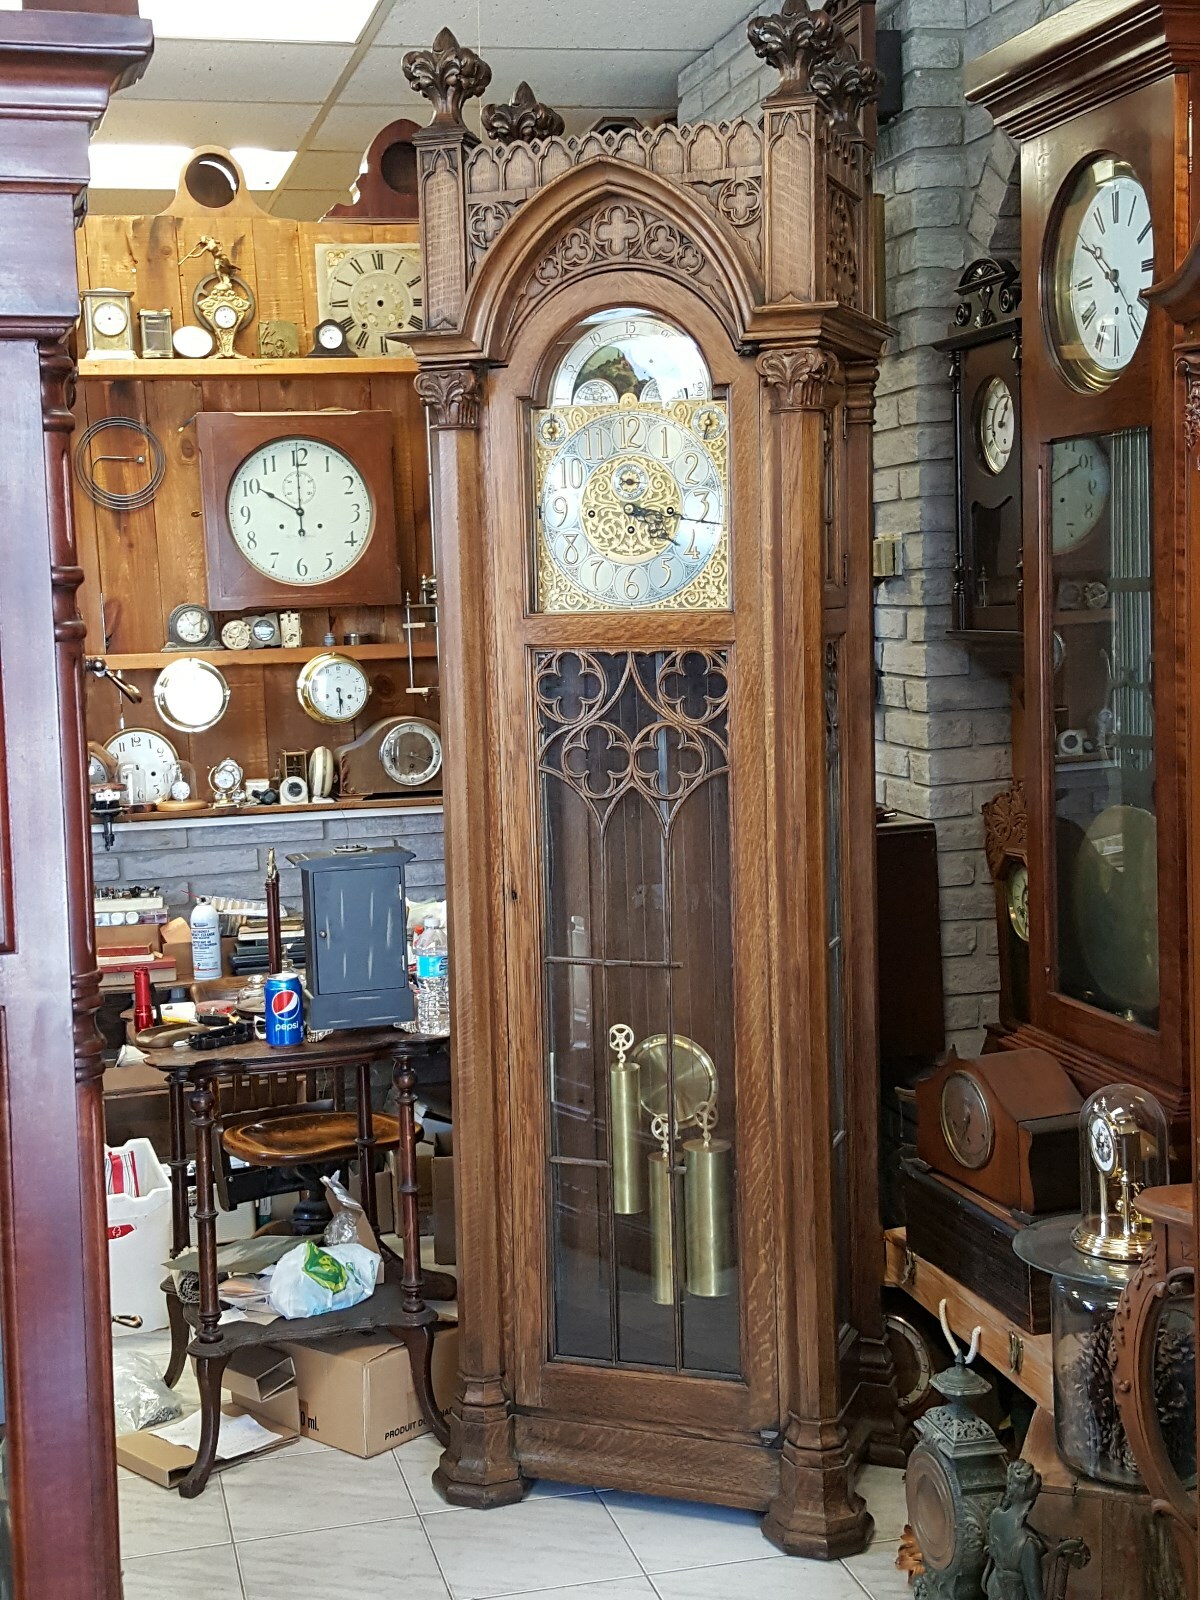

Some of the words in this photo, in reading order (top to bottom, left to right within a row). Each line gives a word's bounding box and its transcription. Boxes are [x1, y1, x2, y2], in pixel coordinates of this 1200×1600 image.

[624, 321, 636, 335] 15
[588, 333, 602, 347] 10
[563, 362, 576, 373] 5
[619, 416, 642, 449] 12
[585, 429, 606, 461] 11
[660, 426, 669, 459] 1
[263, 455, 276, 475] 11
[291, 448, 308, 467] 12
[325, 456, 330, 472] 1
[560, 458, 583, 490] 10
[685, 455, 700, 486] 2
[243, 478, 260, 497] 10
[342, 476, 354, 495] 2
[240, 505, 251, 525] 9
[350, 503, 360, 523] 3
[553, 497, 568, 527] 9
[693, 490, 709, 523] 3
[247, 531, 257, 550] 8
[344, 530, 358, 547] 4
[683, 530, 701, 560] 4
[563, 534, 581, 565] 8
[270, 552, 279, 569] 7
[296, 558, 308, 577] 6
[322, 552, 334, 572] 5
[591, 561, 607, 591] 7
[658, 556, 673, 588] 5
[624, 568, 640, 600] 6
[118, 742, 125, 752] 11
[131, 736, 141, 747] 12
[148, 739, 152, 749] 1
[153, 784, 160, 795] 5
[275, 1021, 299, 1033] pepsi
[308, 1416, 319, 1431] ml.
[384, 1420, 416, 1440] PRODUIT
